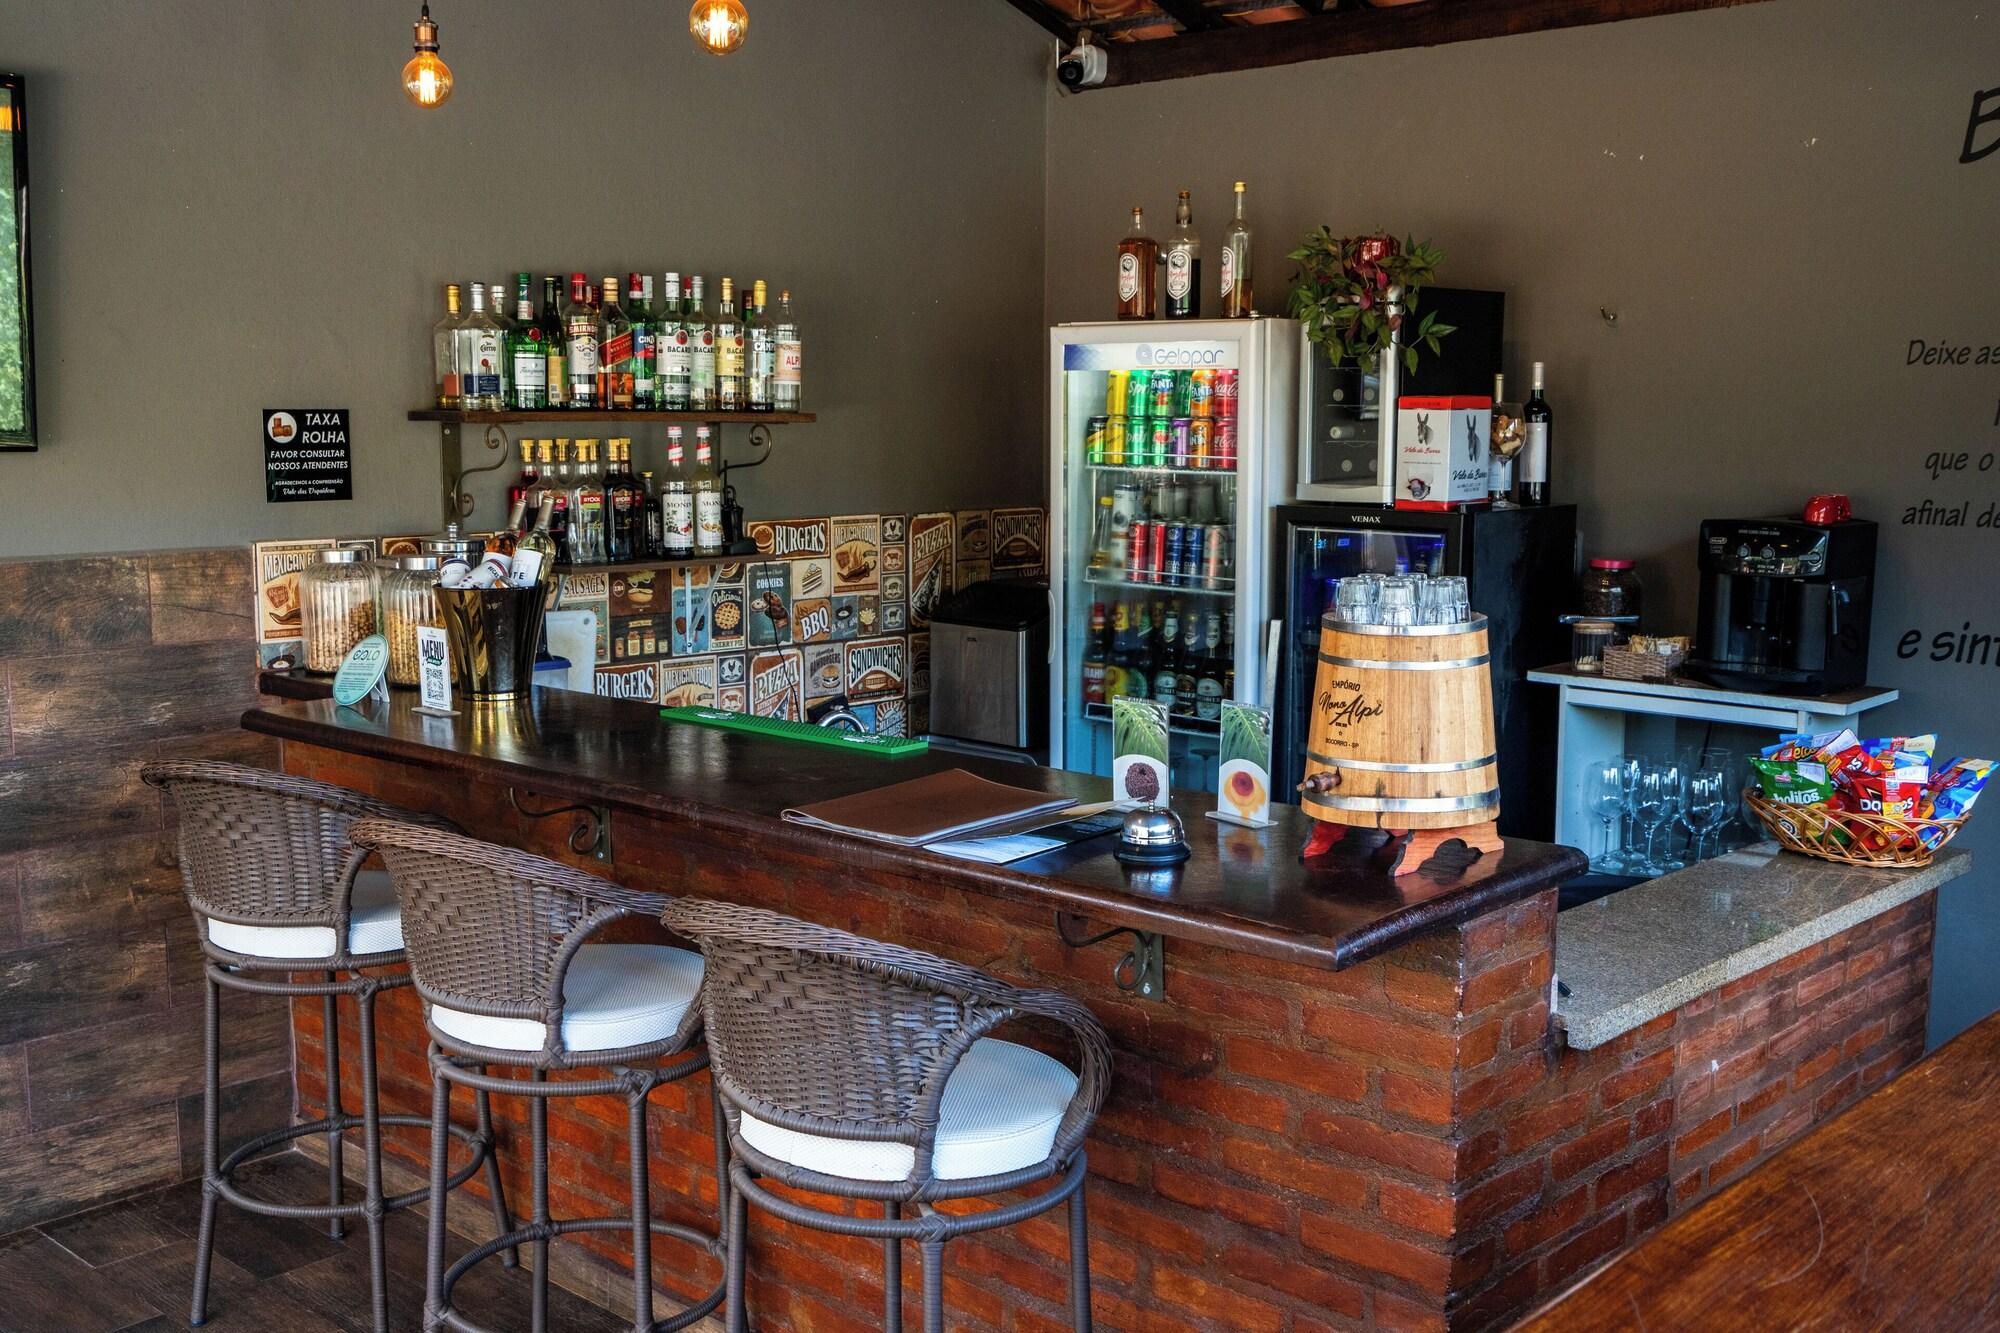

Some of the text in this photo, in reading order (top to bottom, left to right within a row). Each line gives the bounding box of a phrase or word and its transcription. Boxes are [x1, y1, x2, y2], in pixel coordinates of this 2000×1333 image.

[1154, 348, 1224, 366] Gelopar
[1906, 339, 1970, 365] Deixe
[1152, 379, 1174, 389] FANTA
[305, 413, 340, 426] TAXA
[302, 431, 346, 444] ROLHA
[268, 461, 349, 470] NOSSOS ATENDENTES
[270, 449, 345, 459] FAVOR CONSULTAR
[1925, 451, 1969, 480] que
[1351, 515, 1381, 524] VENAX
[1902, 499, 1969, 527] afinal
[775, 522, 826, 555] BURGERS
[914, 522, 952, 562] PIZZA
[264, 553, 305, 582] MEXICAN
[564, 575, 606, 595] SAUSAGES
[800, 606, 830, 641] BBQ
[421, 639, 445, 661] MENU
[1896, 628, 1922, 660] e
[850, 644, 902, 683] SANDWICHES
[595, 666, 655, 699] BURGERS
[755, 659, 799, 702] PIZZA
[1331, 679, 1361, 692] EMPÓRIO
